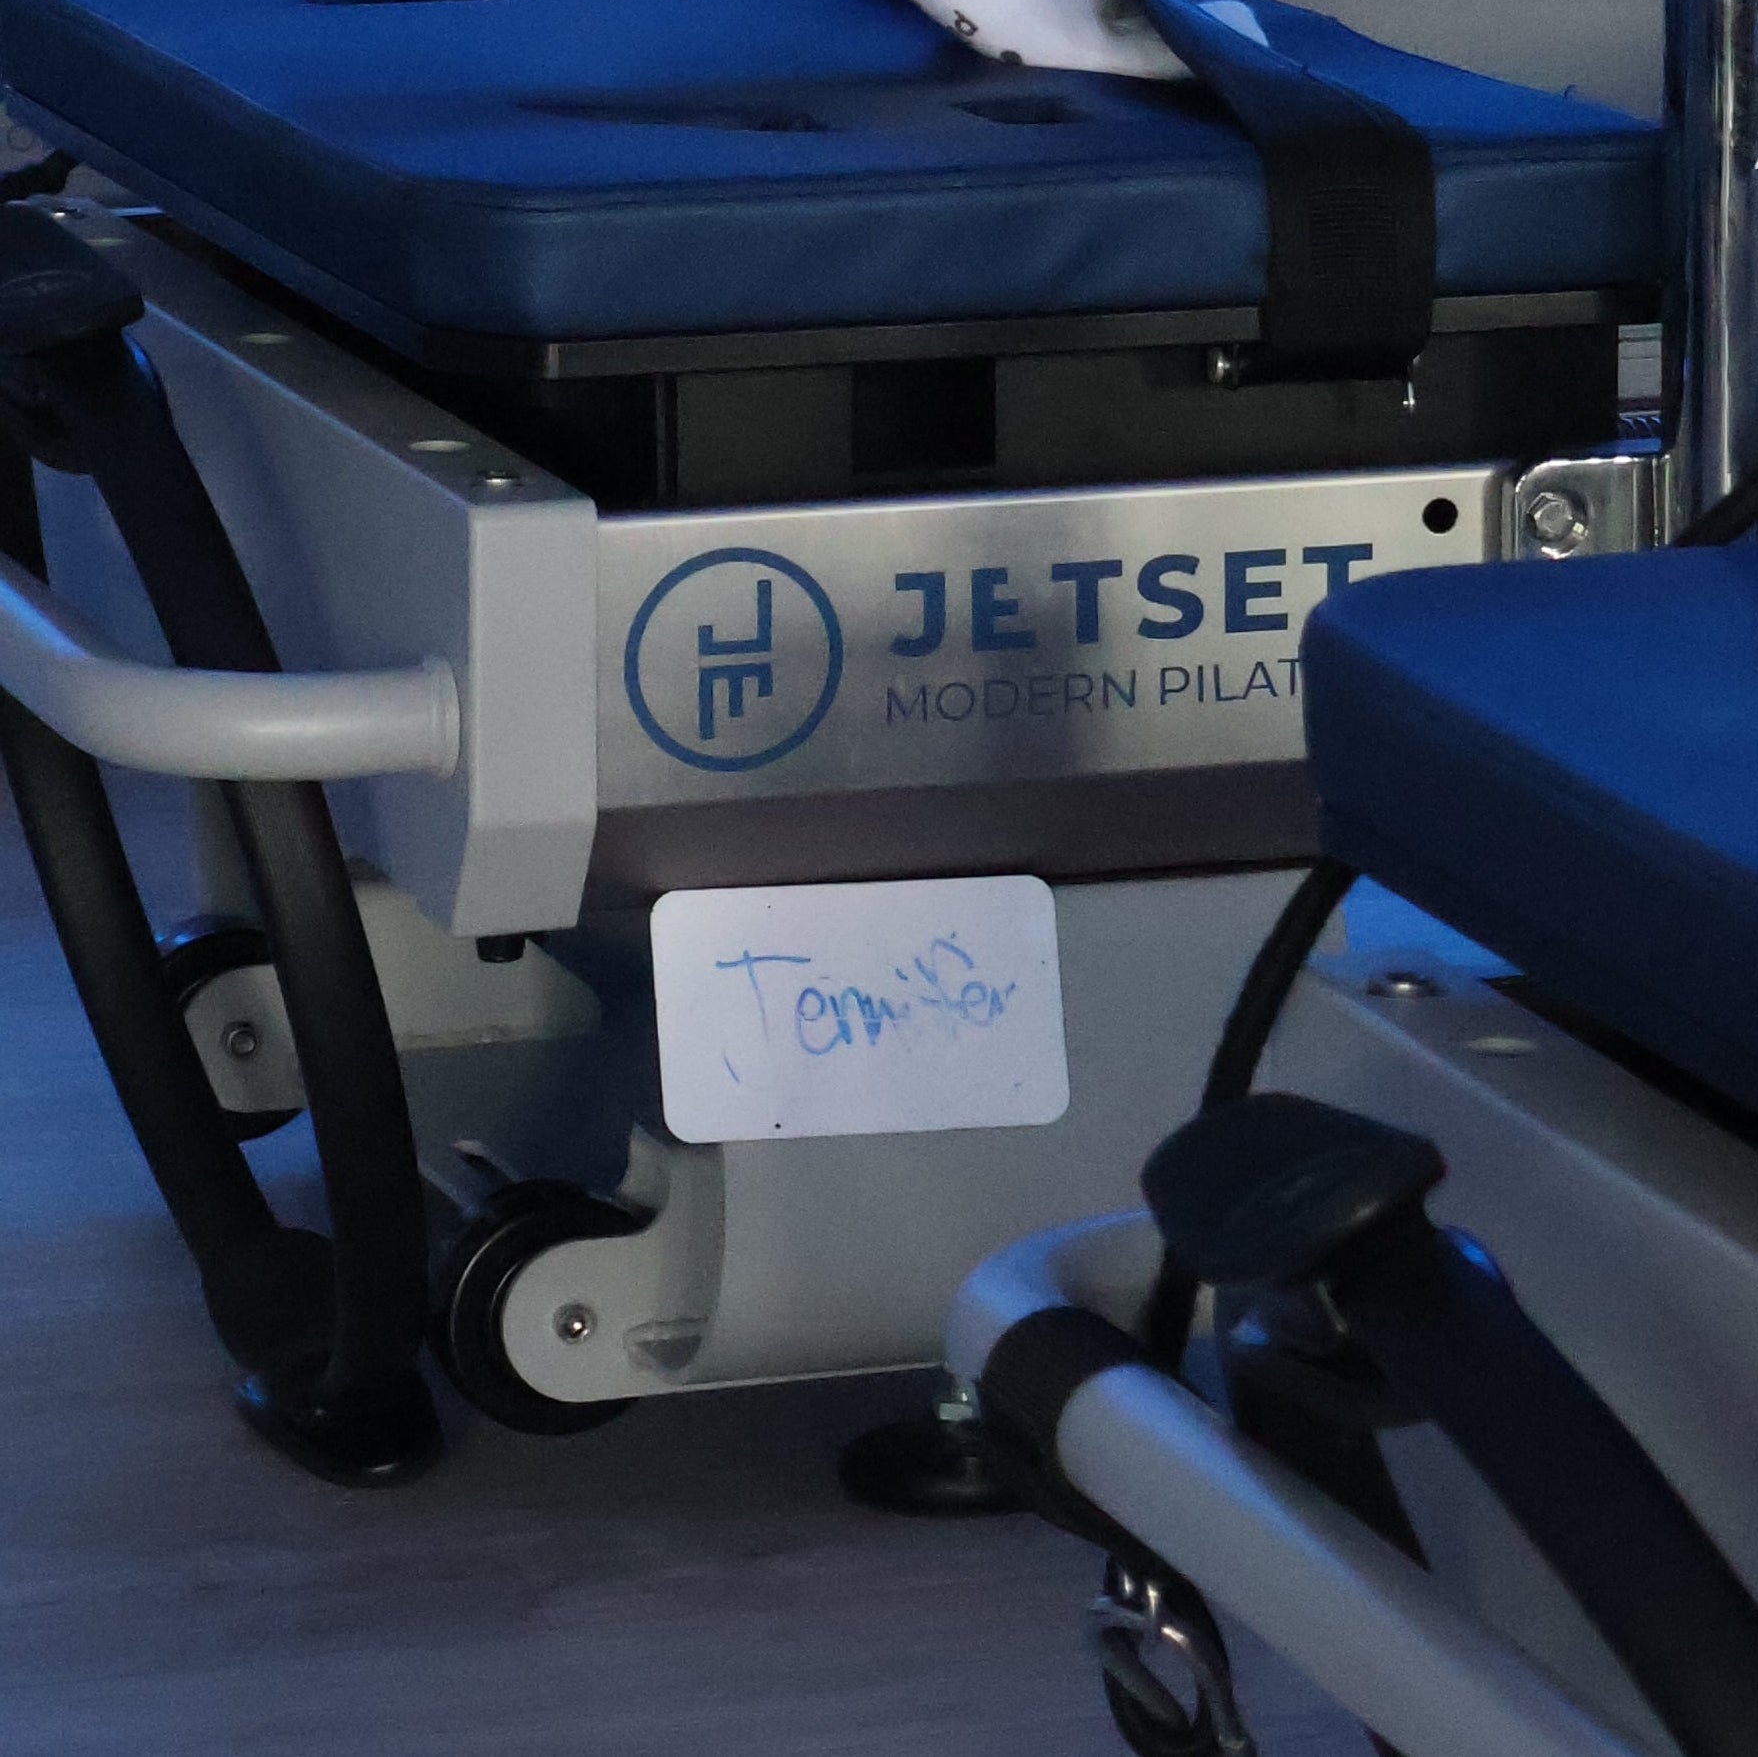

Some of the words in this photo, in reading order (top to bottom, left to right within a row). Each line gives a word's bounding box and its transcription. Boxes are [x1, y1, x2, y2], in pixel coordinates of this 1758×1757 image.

[892, 543, 1373, 659] JETSET
[886, 667, 1137, 726] MODERN
[1159, 657, 1301, 706] PILAT
